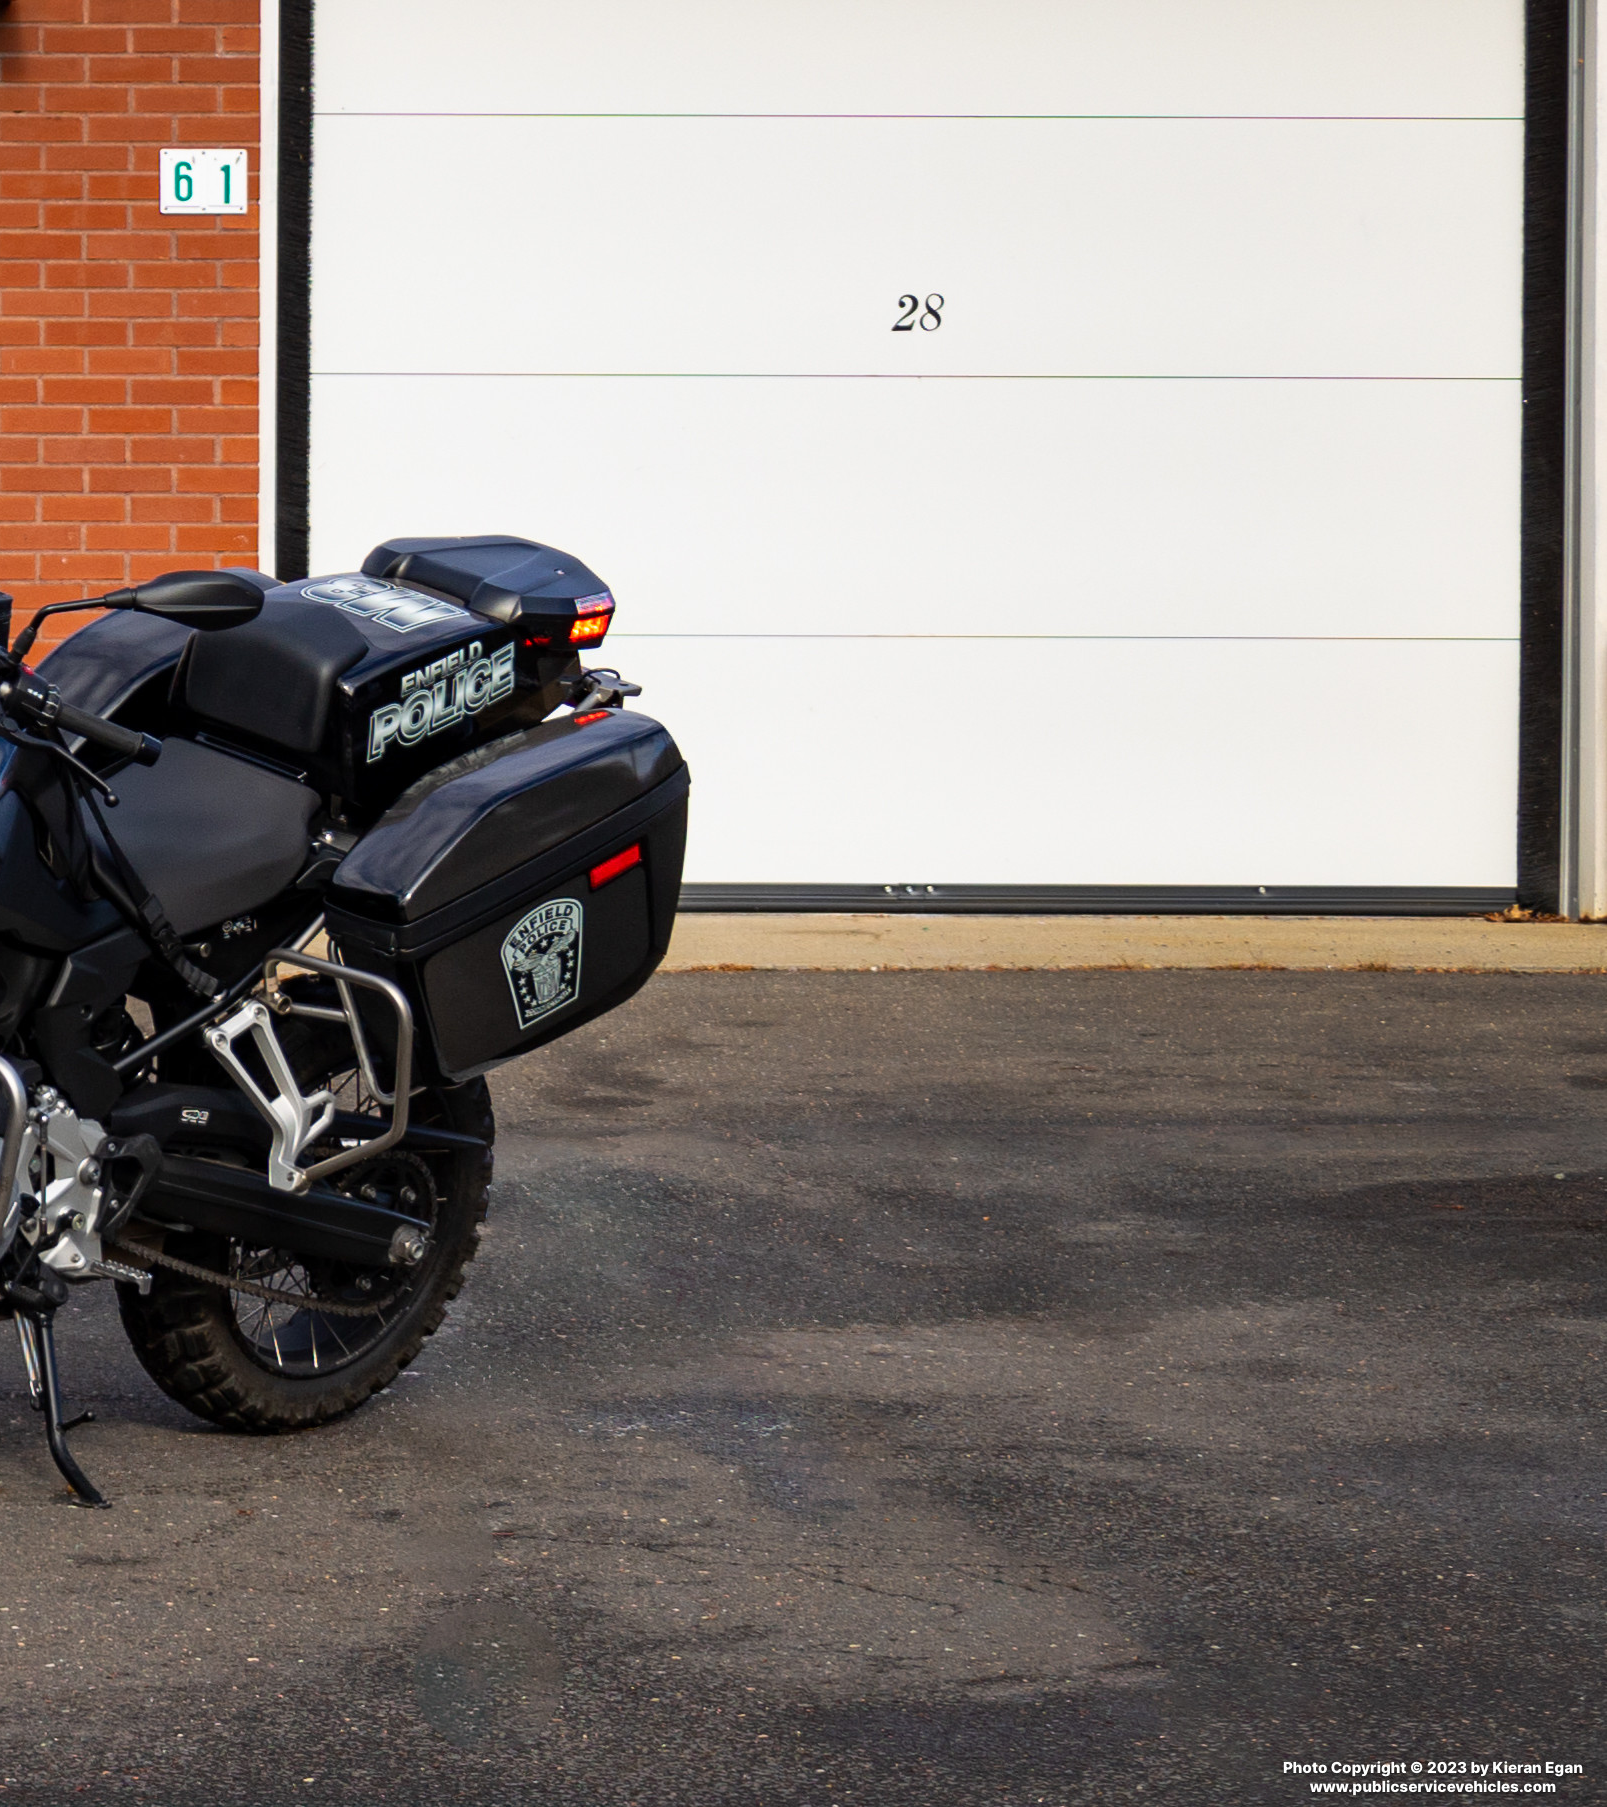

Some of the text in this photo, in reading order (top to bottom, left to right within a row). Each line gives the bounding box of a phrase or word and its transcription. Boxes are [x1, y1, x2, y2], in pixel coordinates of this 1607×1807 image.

[891, 292, 945, 332] 28
[400, 641, 483, 698] ENFIELD
[367, 641, 515, 763] POLICE
[509, 904, 574, 949] ENFIELD
[518, 920, 568, 954] POLICE
